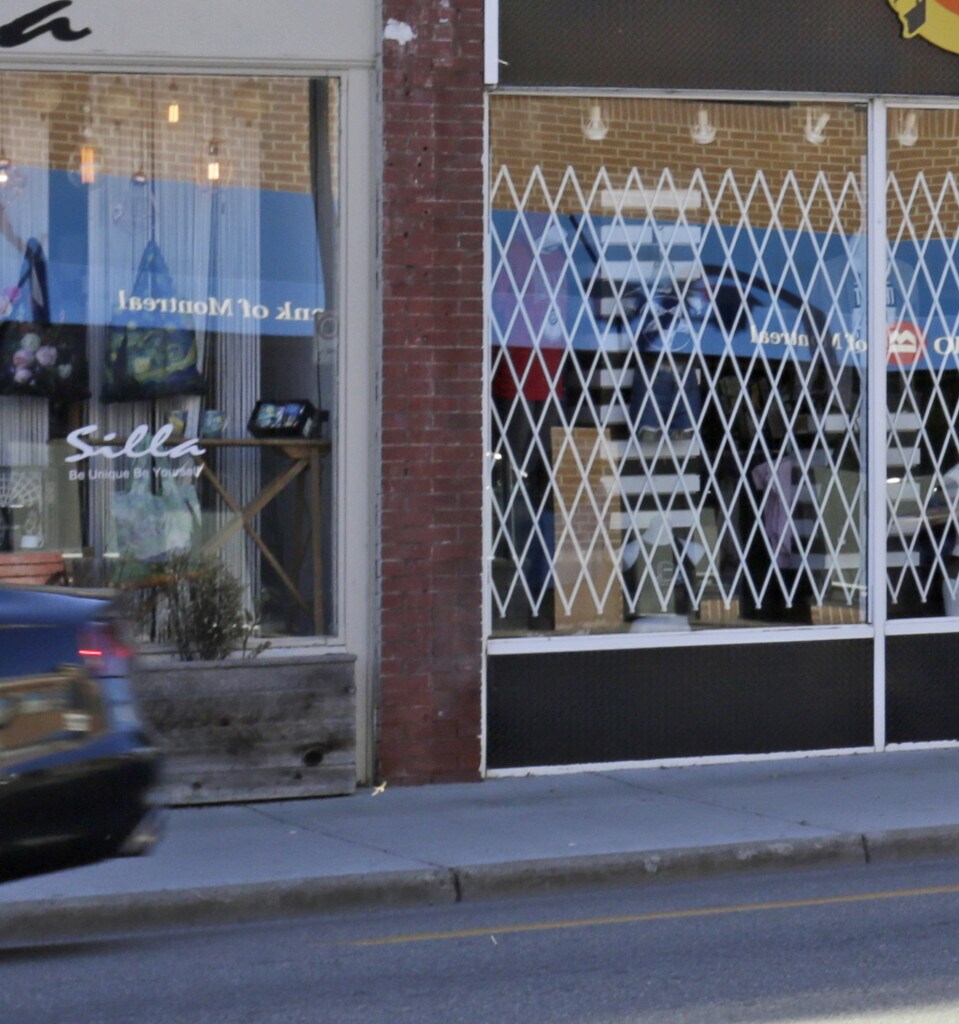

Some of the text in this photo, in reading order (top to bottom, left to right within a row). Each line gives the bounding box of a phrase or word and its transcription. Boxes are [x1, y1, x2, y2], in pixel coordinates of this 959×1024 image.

[64, 423, 206, 463] Silla
[68, 469, 85, 481] Be
[88, 469, 130, 482] Unique
[133, 467, 149, 479] Be
